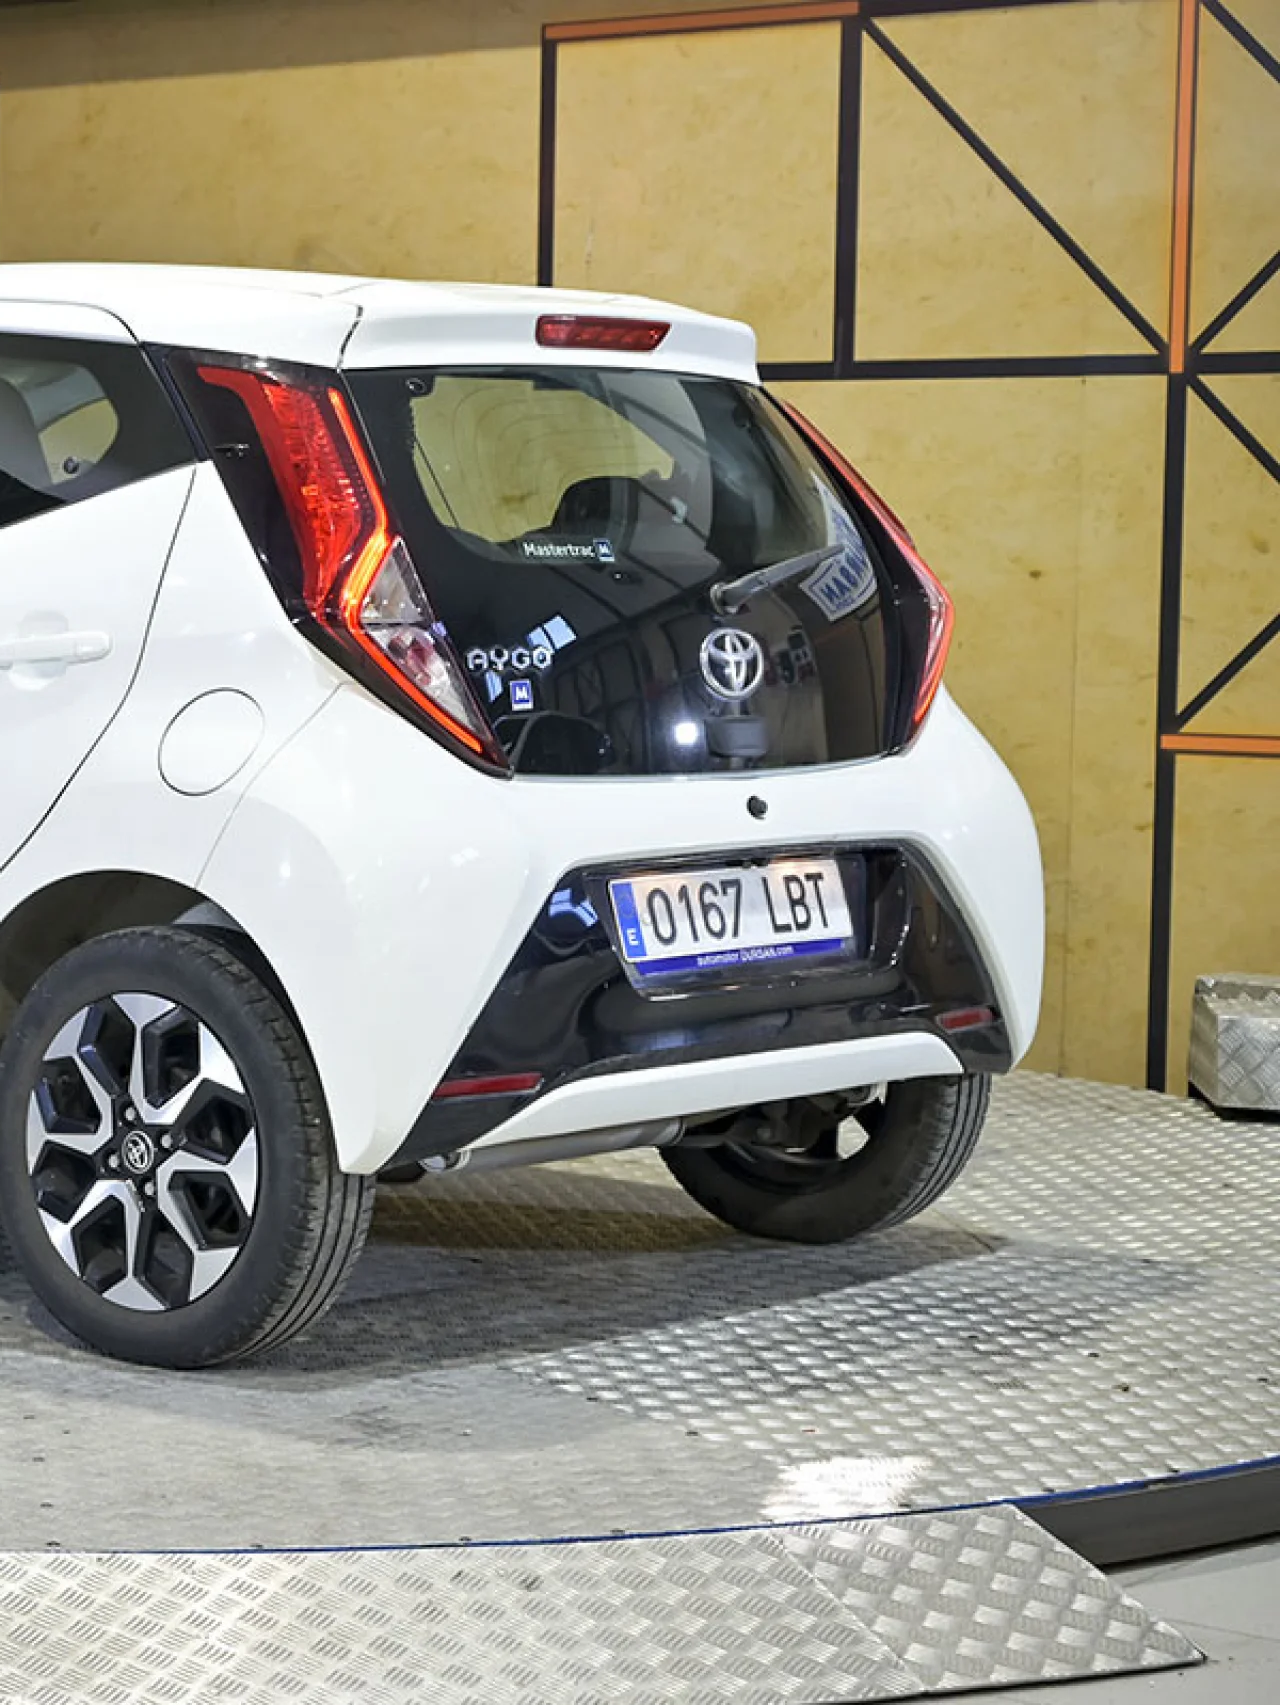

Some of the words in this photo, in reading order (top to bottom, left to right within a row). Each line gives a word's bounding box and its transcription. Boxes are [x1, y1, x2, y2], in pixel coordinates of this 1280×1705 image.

[466, 645, 552, 671] AYGO
[646, 878, 742, 945] 0167
[761, 872, 828, 933] LBT
[626, 927, 639, 946] E
